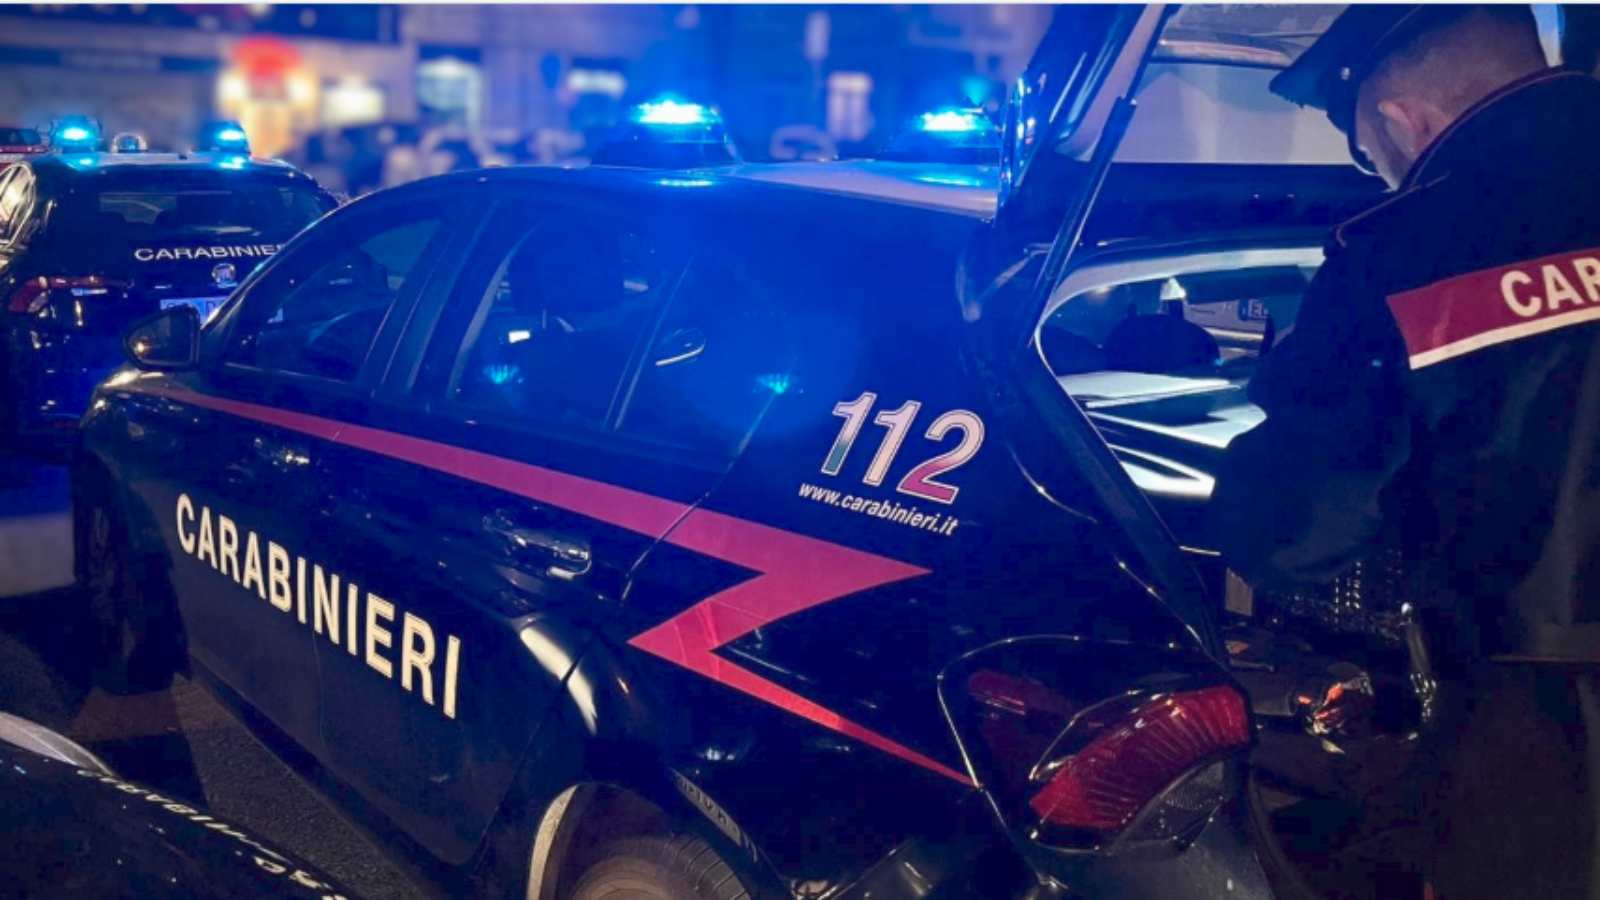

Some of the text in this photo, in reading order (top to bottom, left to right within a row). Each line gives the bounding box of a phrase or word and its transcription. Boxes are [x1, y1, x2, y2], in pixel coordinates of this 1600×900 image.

[821, 391, 985, 504] 112
[799, 483, 958, 536] www.carabinieri.it
[176, 493, 461, 720] CARABINIERI
